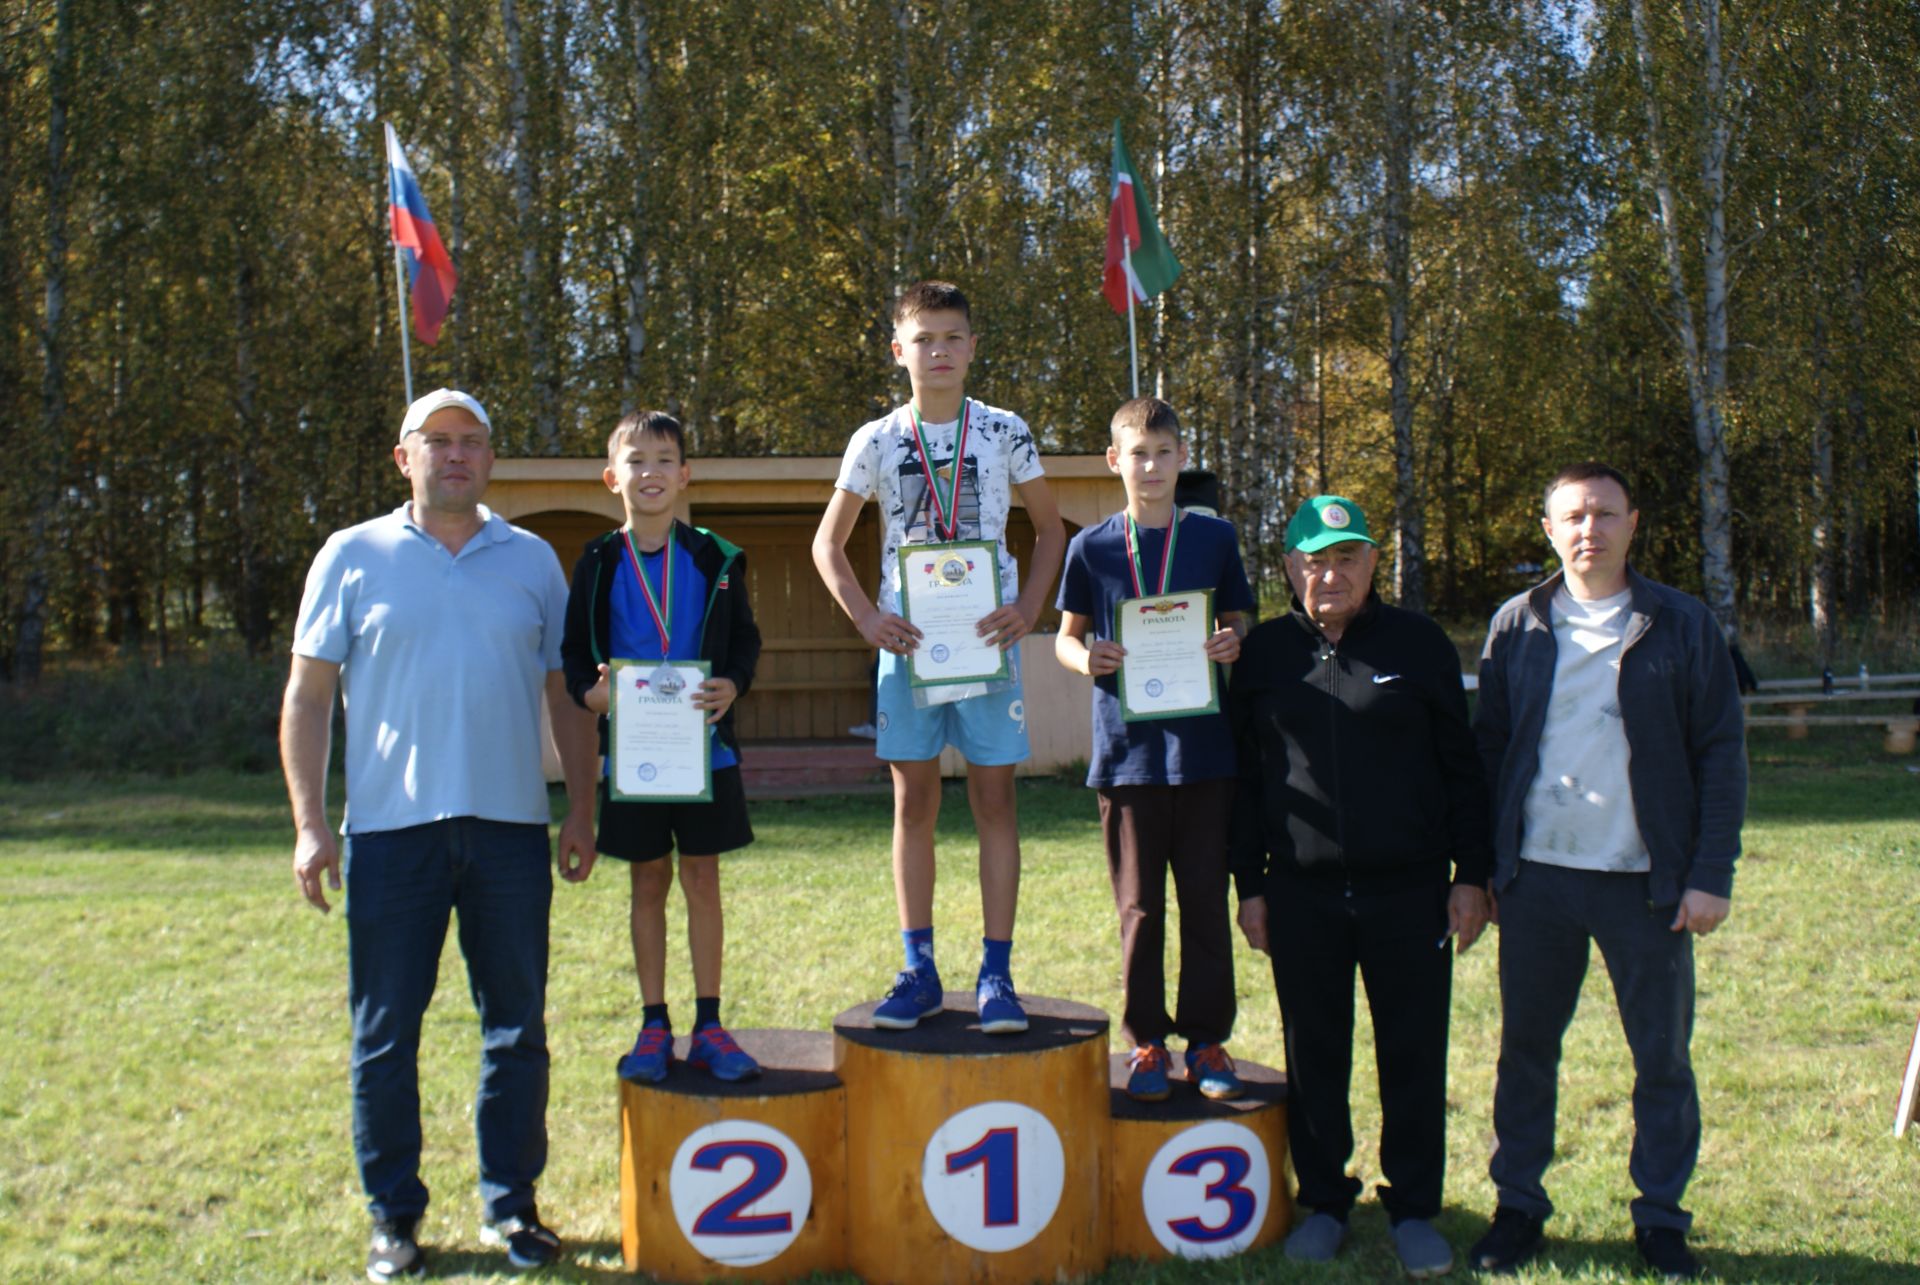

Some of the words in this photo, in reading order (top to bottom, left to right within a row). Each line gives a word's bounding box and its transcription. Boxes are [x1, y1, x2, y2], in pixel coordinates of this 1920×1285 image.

[928, 578, 973, 588] ГРТА
[1142, 615, 1186, 625] ГРАМОТА
[690, 1139, 793, 1236] 2
[945, 1126, 1019, 1228] 1
[1167, 1146, 1257, 1243] 3
